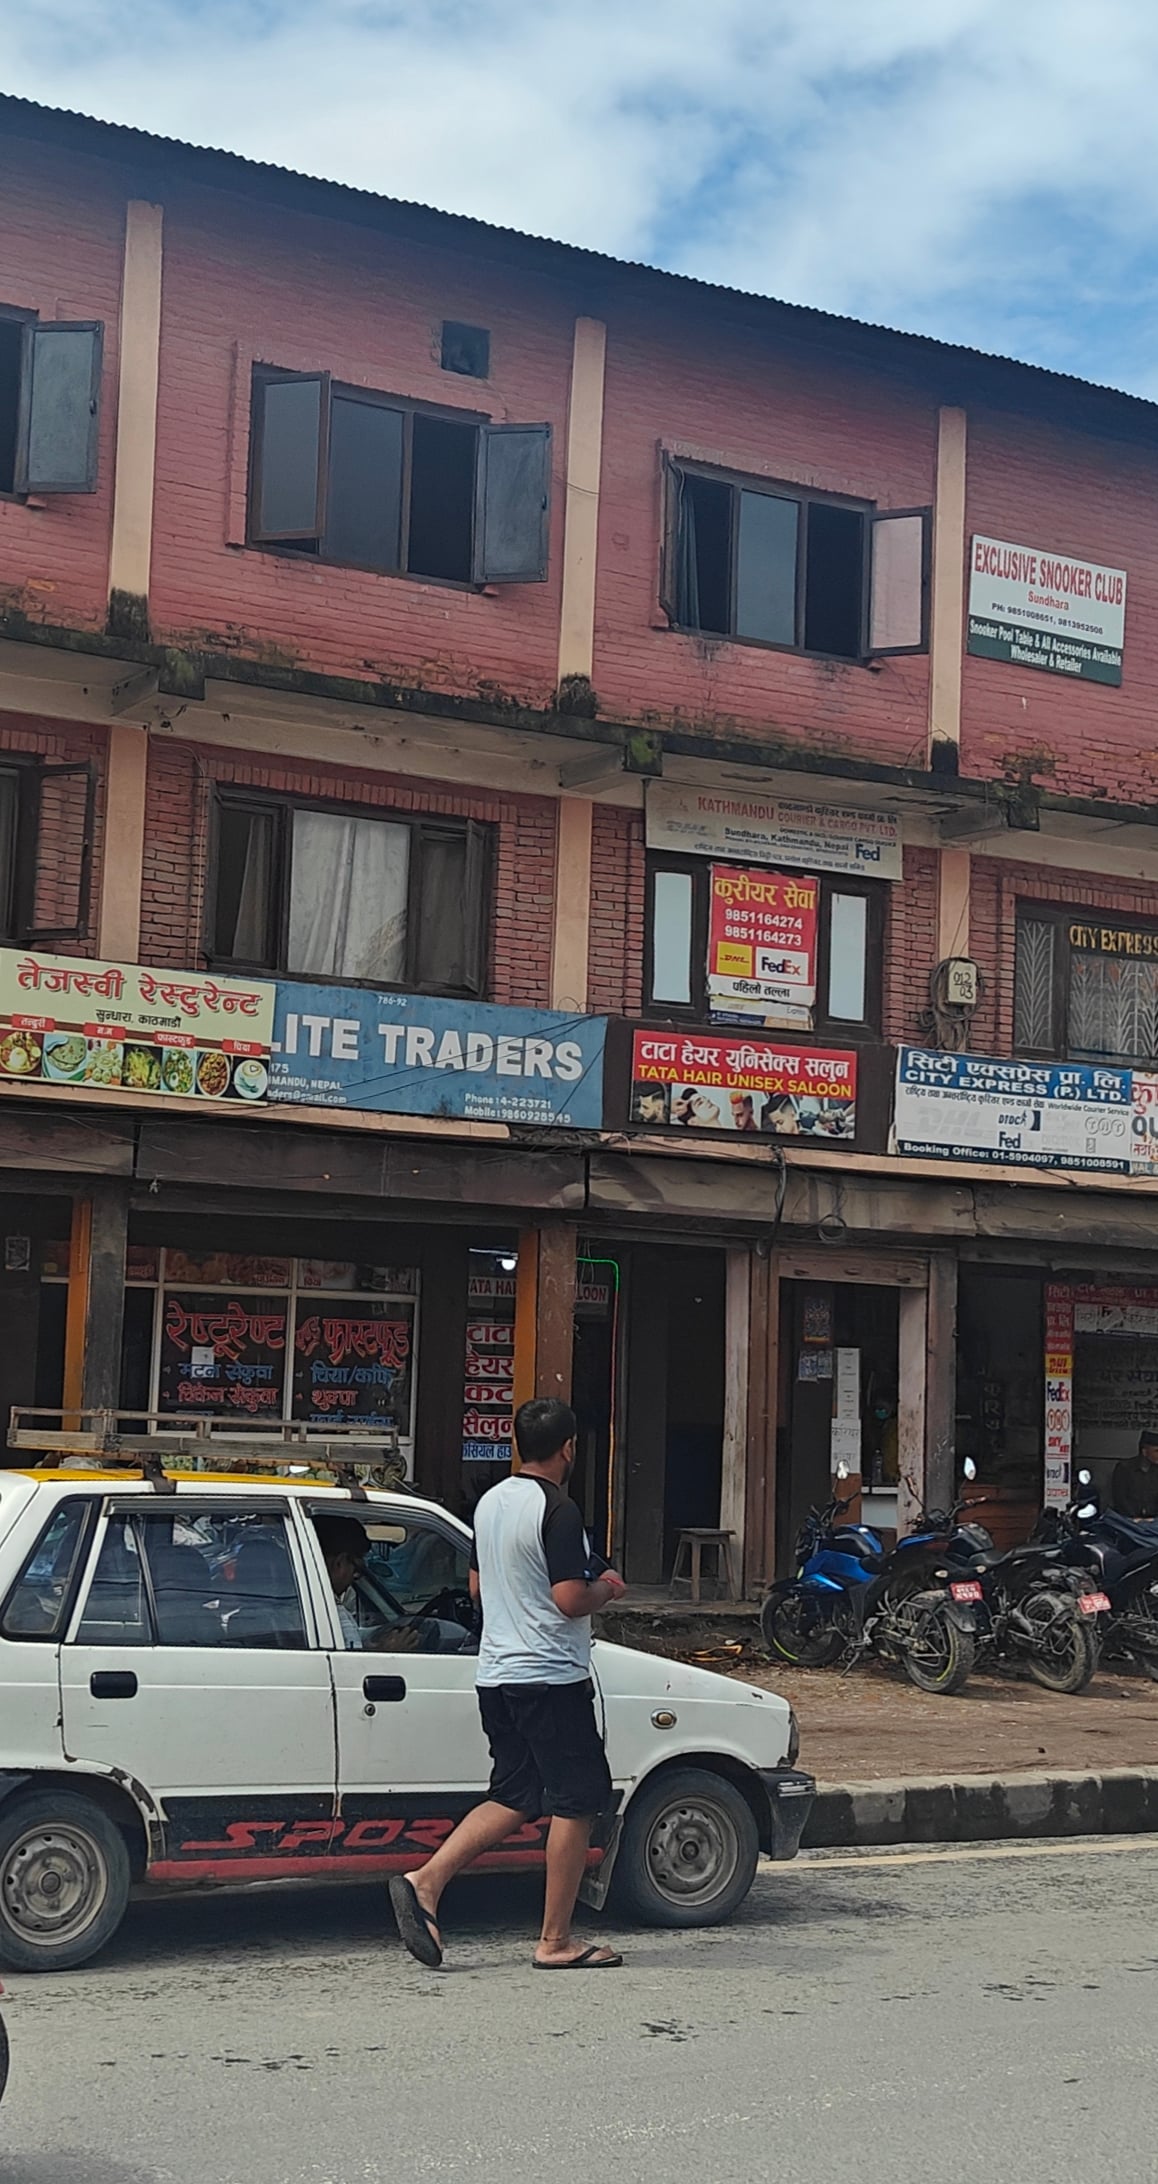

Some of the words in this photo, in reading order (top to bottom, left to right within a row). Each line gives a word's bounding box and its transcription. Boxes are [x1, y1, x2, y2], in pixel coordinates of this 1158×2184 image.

[975, 542, 1036, 585] EXCLUSIVE
[1039, 559, 1092, 599] SNOOKER
[1094, 573, 1123, 605] CLUB
[1028, 591, 1070, 610] Sundhara
[969, 620, 998, 640] Snooker
[998, 625, 1014, 642] Pool
[1015, 629, 1033, 648] Table
[1034, 634, 1040, 648] &
[1042, 635, 1051, 650] All
[1052, 637, 1091, 660] Accessories
[1092, 648, 1122, 666] Available
[1010, 645, 1049, 666] Wholesaler
[1049, 654, 1055, 667] &
[1055, 655, 1082, 673] Retailer
[697, 797, 774, 820] KATHMANDU
[771, 833, 821, 848] Kathmandu,
[824, 840, 849, 853] Nepal
[855, 843, 880, 861] Fed
[784, 881, 815, 910] सेवा
[725, 908, 803, 929] 9851164274
[725, 925, 802, 946] 9851164273
[1069, 924, 1097, 949] CITY
[761, 957, 801, 975] FedEx
[17, 957, 126, 1000] तेजस्वी
[138, 973, 262, 1017] रेस्टुरेन्ट
[732, 980, 762, 995] पहिलो
[764, 985, 790, 998] तल्ला
[378, 995, 407, 1007] 786-92
[378, 1023, 584, 1081] TRADERS
[641, 1041, 677, 1062] टाटा
[681, 1040, 721, 1067] हेयर
[725, 1045, 801, 1076] युनिसेक्स
[805, 1057, 850, 1082] सलुन
[638, 1064, 679, 1082] TATA
[683, 1069, 722, 1086] HAIR
[726, 1074, 784, 1092] UNISEX
[788, 1079, 852, 1097] SALOON
[907, 1050, 958, 1073] सिटी
[967, 1060, 1052, 1083] एक्सप्रेस
[1059, 1070, 1086, 1086] प्रा.
[1093, 1068, 1126, 1089] लि.
[310, 1080, 343, 1091] NEPAL
[905, 1070, 952, 1085] CITY
[958, 1076, 1048, 1095] EXPRESS
[1053, 1084, 1081, 1099] (P.)
[1087, 1089, 1127, 1102] LTD.
[465, 1093, 494, 1105] Phone
[1048, 1101, 1082, 1113] Worldwide
[1083, 1104, 1106, 1114] Courier
[1107, 1106, 1129, 1117] Service
[999, 1132, 1022, 1149] Fed
[904, 1142, 949, 1156] Booking
[952, 1146, 989, 1159] Office:
[992, 1151, 1058, 1166] 01-5904097,
[1060, 1156, 1125, 1169] 9851008591
[467, 1323, 515, 1343] टाटा
